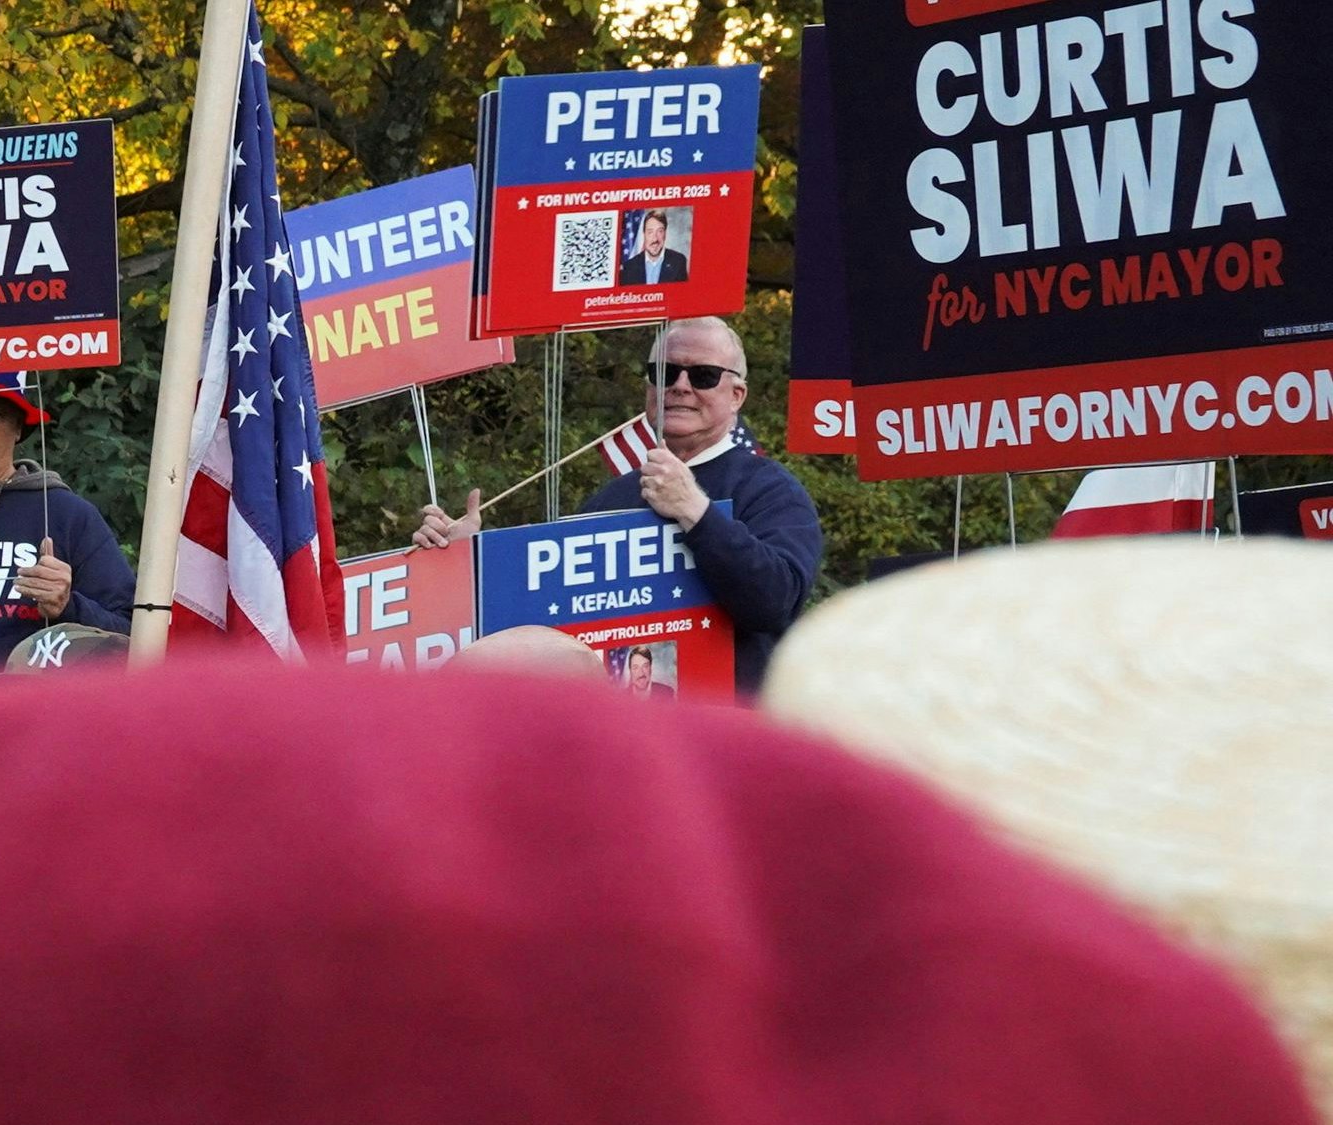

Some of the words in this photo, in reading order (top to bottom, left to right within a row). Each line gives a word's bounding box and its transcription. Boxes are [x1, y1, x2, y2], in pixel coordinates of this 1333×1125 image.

[916, 0, 1258, 136] CURTIS
[546, 83, 721, 143] PETER
[589, 148, 672, 170] KEFALAS
[907, 99, 1286, 263] SLIWA
[537, 195, 561, 208] FOR
[564, 192, 589, 205] NYC
[592, 186, 681, 204] COMPTROLLER
[683, 184, 711, 198] 2025
[289, 200, 475, 291] UNTEER
[305, 286, 438, 362] NATE
[584, 292, 664, 309] peterkefalas.com
[923, 274, 985, 349] for
[995, 263, 1090, 317] NYC
[1101, 239, 1283, 305] MAYOR
[343, 564, 409, 636] TE
[572, 586, 652, 614] KEFALAS
[27, 631, 71, 668] NY
[577, 622, 664, 645] COMPTROLLER
[665, 618, 693, 634] 2025
